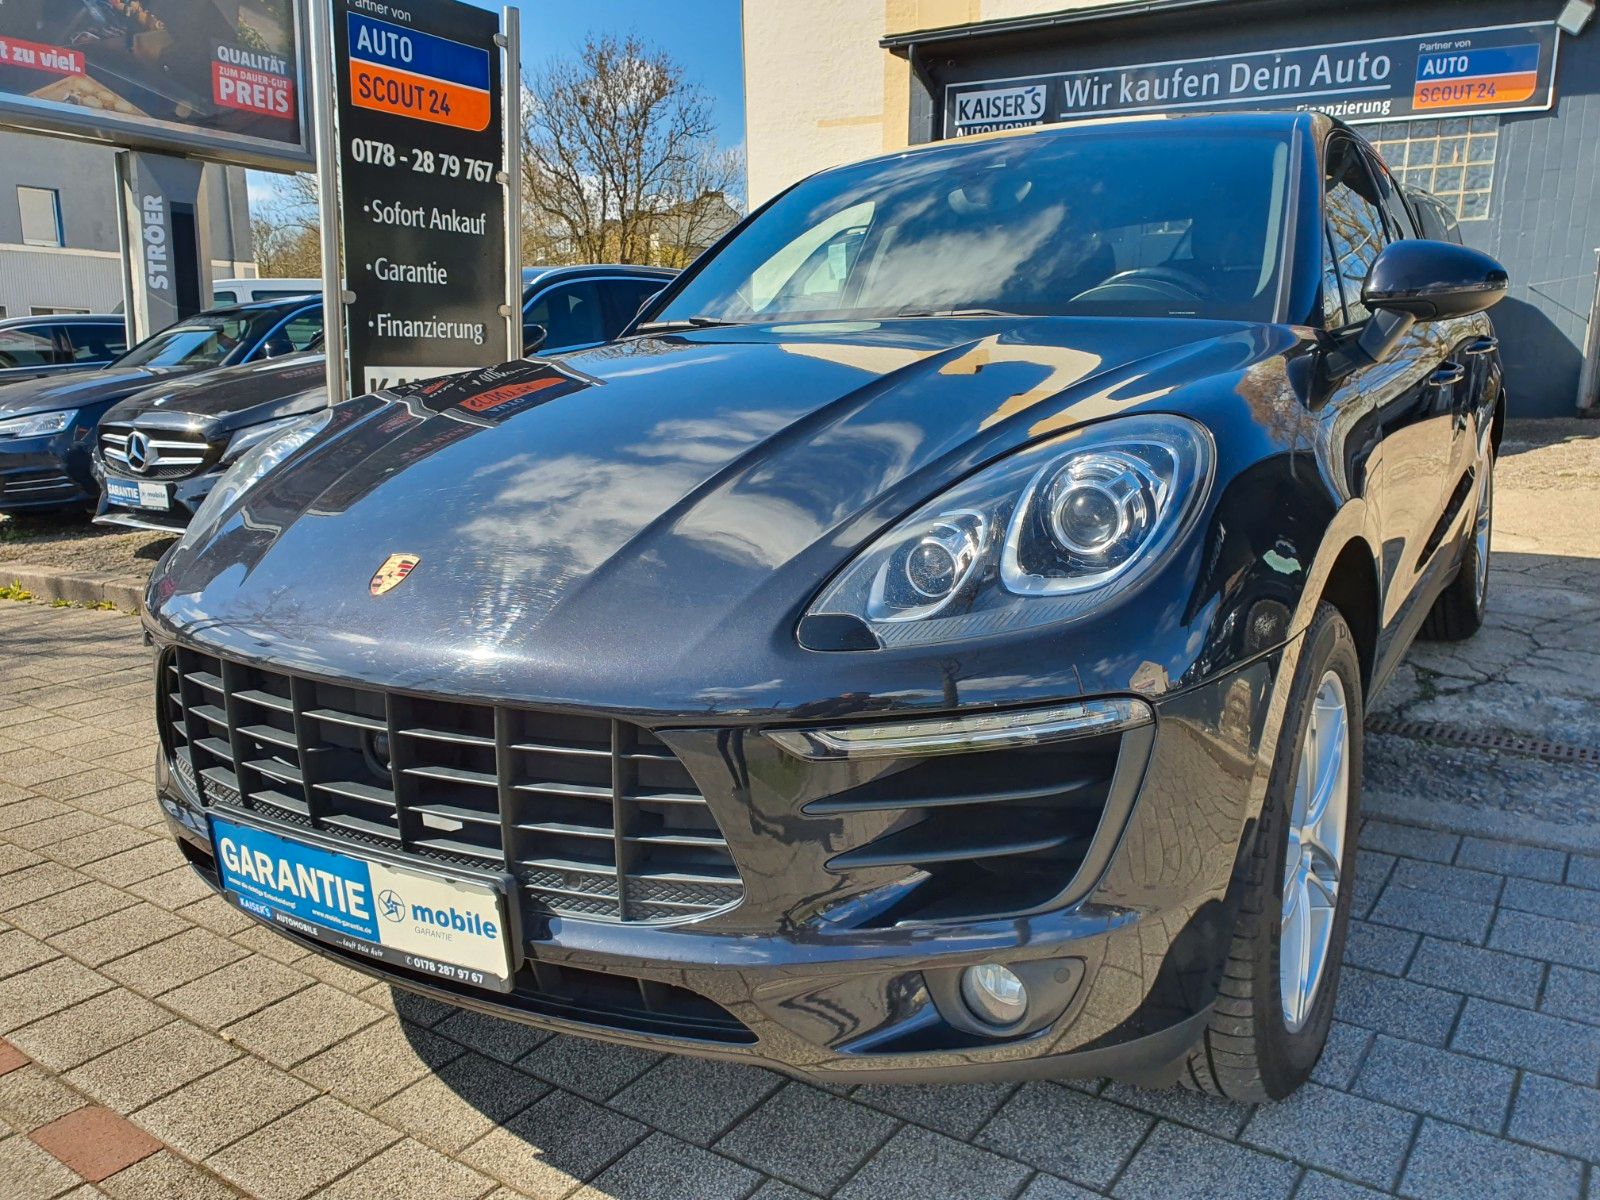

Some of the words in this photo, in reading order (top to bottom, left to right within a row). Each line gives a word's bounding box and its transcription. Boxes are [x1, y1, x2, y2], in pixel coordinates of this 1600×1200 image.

[391, 7, 411, 22] von
[357, 25, 413, 63] AUTO
[1419, 41, 1453, 52] Partner
[1454, 39, 1471, 48] von
[12, 46, 35, 64] zu
[40, 49, 81, 73] viel.
[217, 45, 287, 75] QUALITÄT
[1423, 56, 1469, 76] AUTO
[218, 66, 239, 78] ZUM
[240, 70, 287, 88] DAUER-GUT
[1064, 79, 1112, 107] Wir
[1119, 67, 1220, 104] kaufen
[1229, 53, 1301, 94] Dein
[1309, 51, 1391, 86] Auto
[219, 77, 289, 113] PREIS
[956, 121, 1044, 138] AUTOMO
[352, 138, 396, 168] 0178
[412, 149, 435, 174] 28
[439, 153, 460, 178] 79
[464, 158, 493, 183] 767
[372, 199, 425, 229] Sofort
[429, 208, 486, 236] Ankauf
[143, 194, 169, 291] STRÖER
[374, 257, 448, 285] Garantie
[376, 313, 484, 345] Finanzierung
[107, 483, 140, 499] GARANTIE
[220, 837, 370, 921] GARANTIE
[276, 913, 319, 936] AUTOMOBILE
[411, 904, 498, 939] mobile
[414, 926, 453, 942] GARANTIE
[413, 957, 436, 972] 0178
[437, 964, 455, 977] 287
[457, 969, 470, 981] 97
[471, 972, 484, 984] 67
